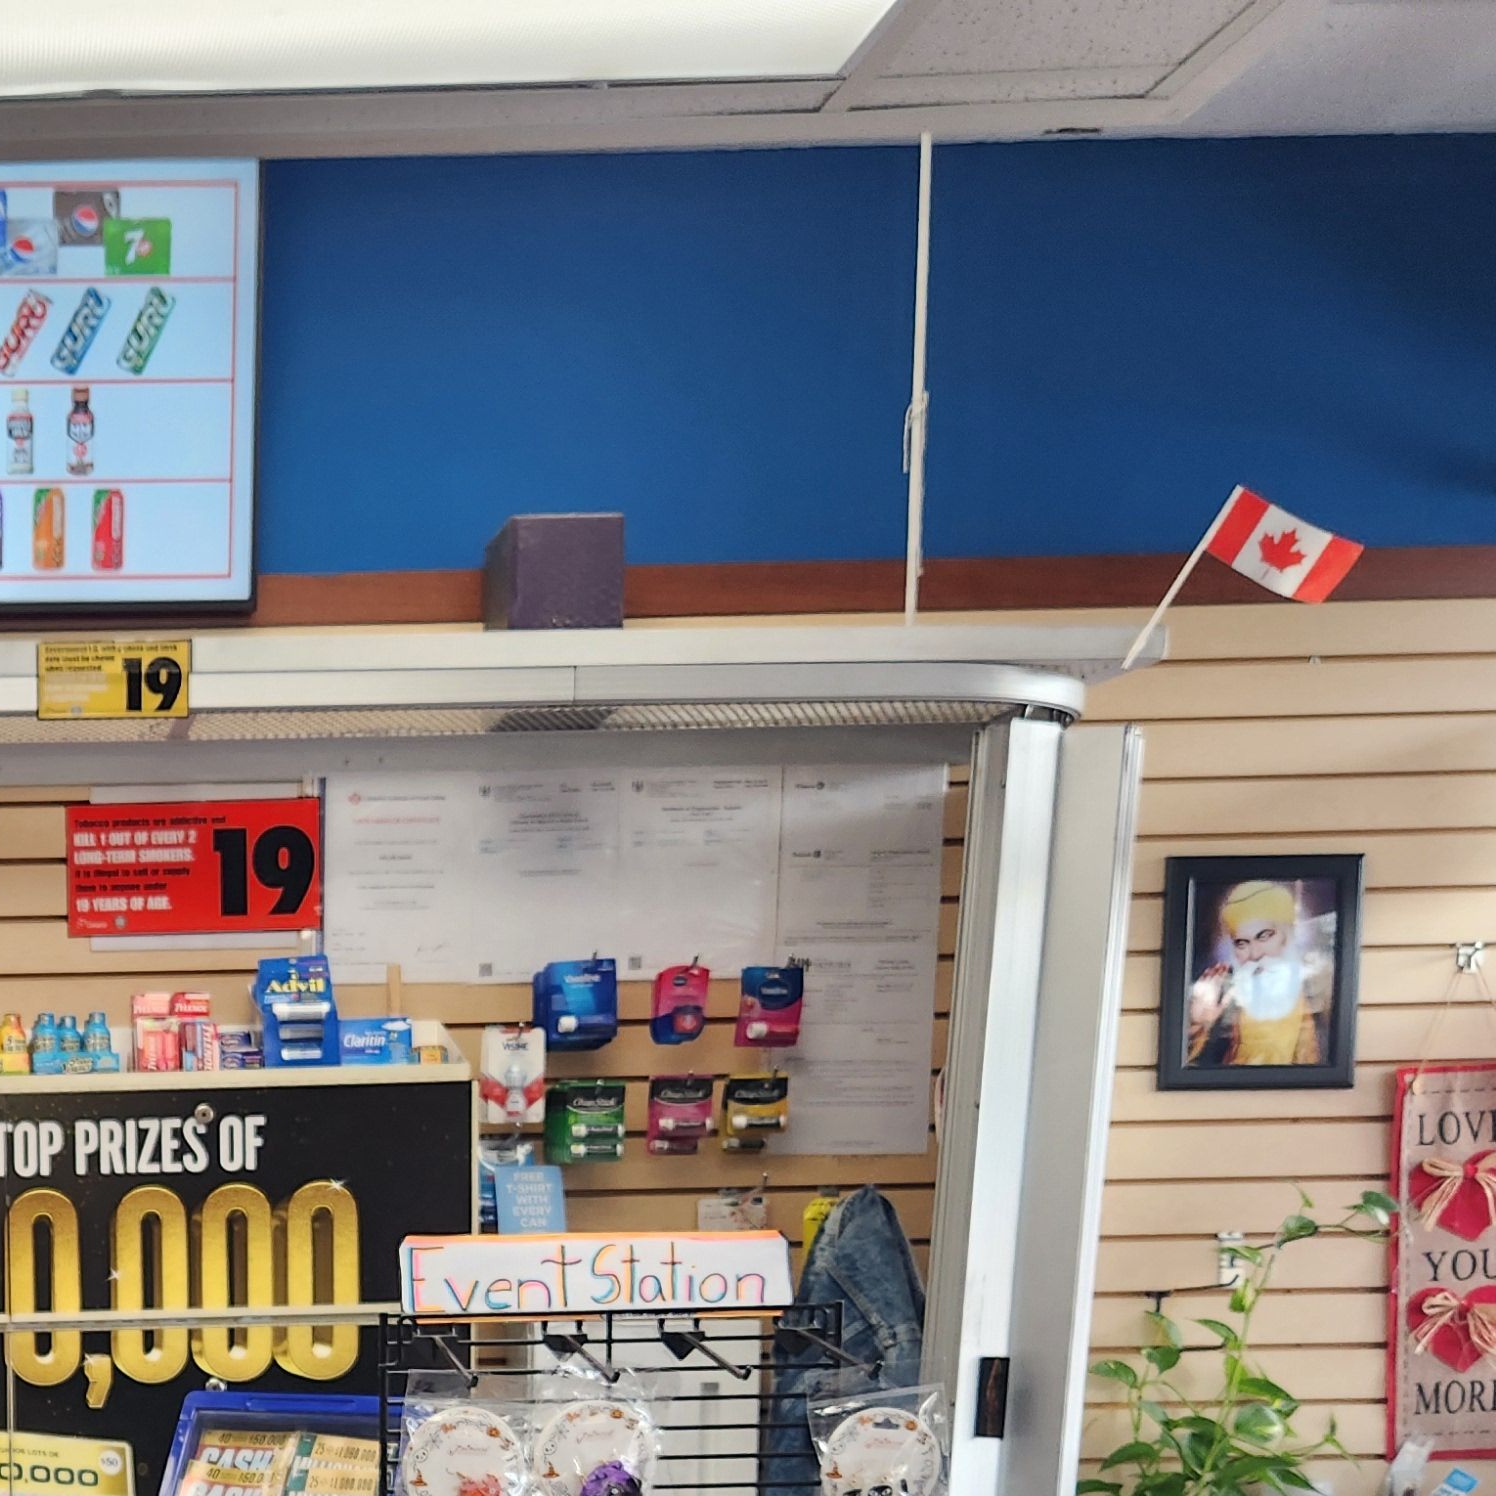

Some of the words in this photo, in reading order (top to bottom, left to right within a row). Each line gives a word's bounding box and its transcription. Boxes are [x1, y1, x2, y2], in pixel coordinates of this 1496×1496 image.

[124, 657, 183, 712] 19
[213, 825, 315, 917] 19
[266, 973, 325, 993] Advil
[343, 1031, 386, 1047] Claritin
[75, 1115, 208, 1178] PRIZES
[219, 1115, 268, 1172] OF
[411, 1244, 583, 1313] Event
[591, 1244, 767, 1305] Station
[200, 1447, 274, 1470] CASH
